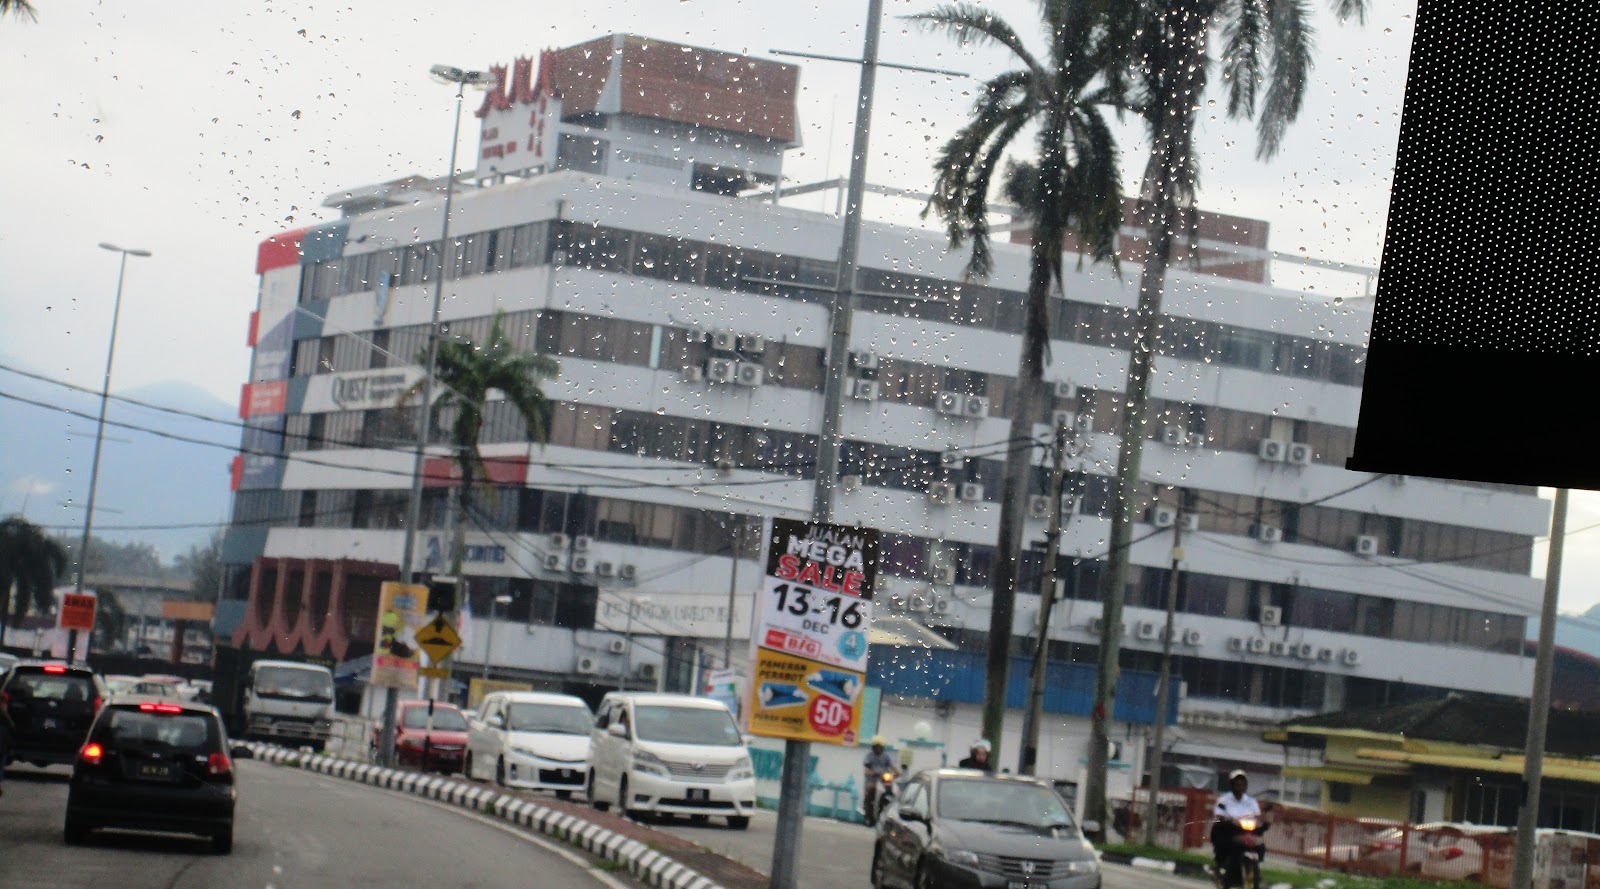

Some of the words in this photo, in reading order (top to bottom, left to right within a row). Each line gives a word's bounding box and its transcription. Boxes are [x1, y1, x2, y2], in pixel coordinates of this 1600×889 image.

[805, 525, 865, 550] JUALAN
[786, 534, 864, 572] MEGA
[777, 554, 865, 597] SALE
[773, 583, 862, 629] 13-16
[802, 620, 829, 635] DEC
[758, 669, 805, 681] PERABOT
[759, 659, 807, 672] PAMERAN
[813, 698, 851, 727] 50%
